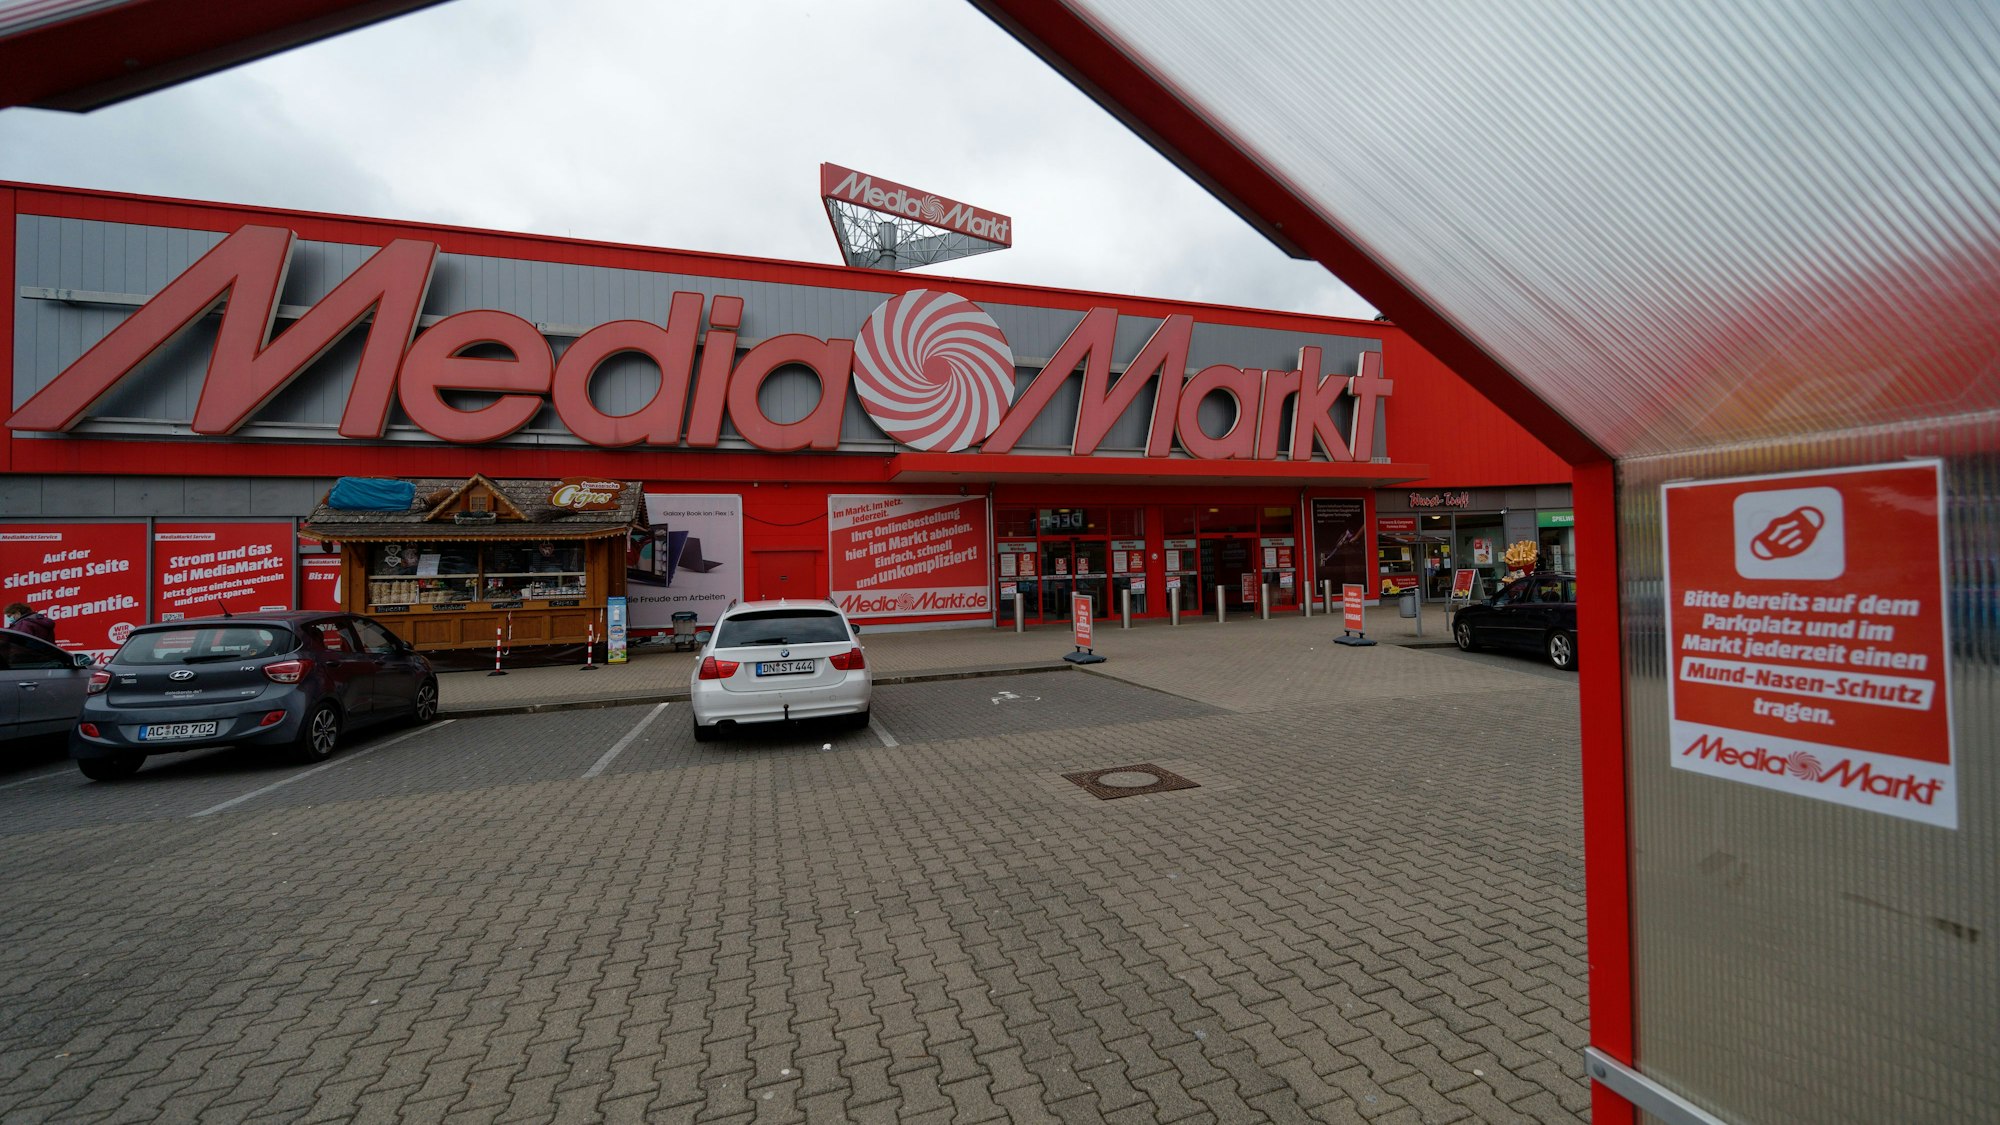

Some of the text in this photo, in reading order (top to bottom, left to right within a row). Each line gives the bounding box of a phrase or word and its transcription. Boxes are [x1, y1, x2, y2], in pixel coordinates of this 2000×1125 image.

[832, 171, 1009, 242] Media Markt
[5, 224, 1394, 462] Media Markt
[552, 484, 612, 508] Crêpes
[833, 498, 903, 519] Im Markt. Im Netz.
[851, 508, 961, 543] Ihre Onlinebestellung
[852, 510, 889, 525] Jederzeit.
[845, 523, 973, 562] hier im Markt abholen.
[875, 539, 952, 568] Einfach, schnell
[43, 549, 91, 564] Auf der
[170, 544, 272, 569] Strom und Gas
[856, 573, 878, 589] und
[879, 546, 977, 584] unkompliziert!
[4, 559, 129, 588] sicheren Seite
[163, 556, 283, 585] bei MediaMarkt:
[308, 572, 322, 580] Bis
[27, 586, 80, 603] mit der
[163, 573, 284, 599] Jetzt ganz einfach wechseln
[174, 587, 256, 606] und sofort sparen.
[640, 595, 671, 603] Freude
[689, 593, 726, 601] Arbeiten
[840, 591, 987, 613] Media Markt.de
[1683, 590, 1920, 617] Bitte bereits auf dem
[1702, 613, 1895, 642] Parkplatz und im
[1681, 634, 1928, 671] Markt jederzeit einen
[763, 661, 812, 673] DN ST 444
[1686, 662, 1924, 705] Mund-Nasen-Schutz
[1753, 697, 1835, 725] tragen.
[147, 723, 214, 737] AC RB 702
[1683, 734, 1943, 805] Media Markt
